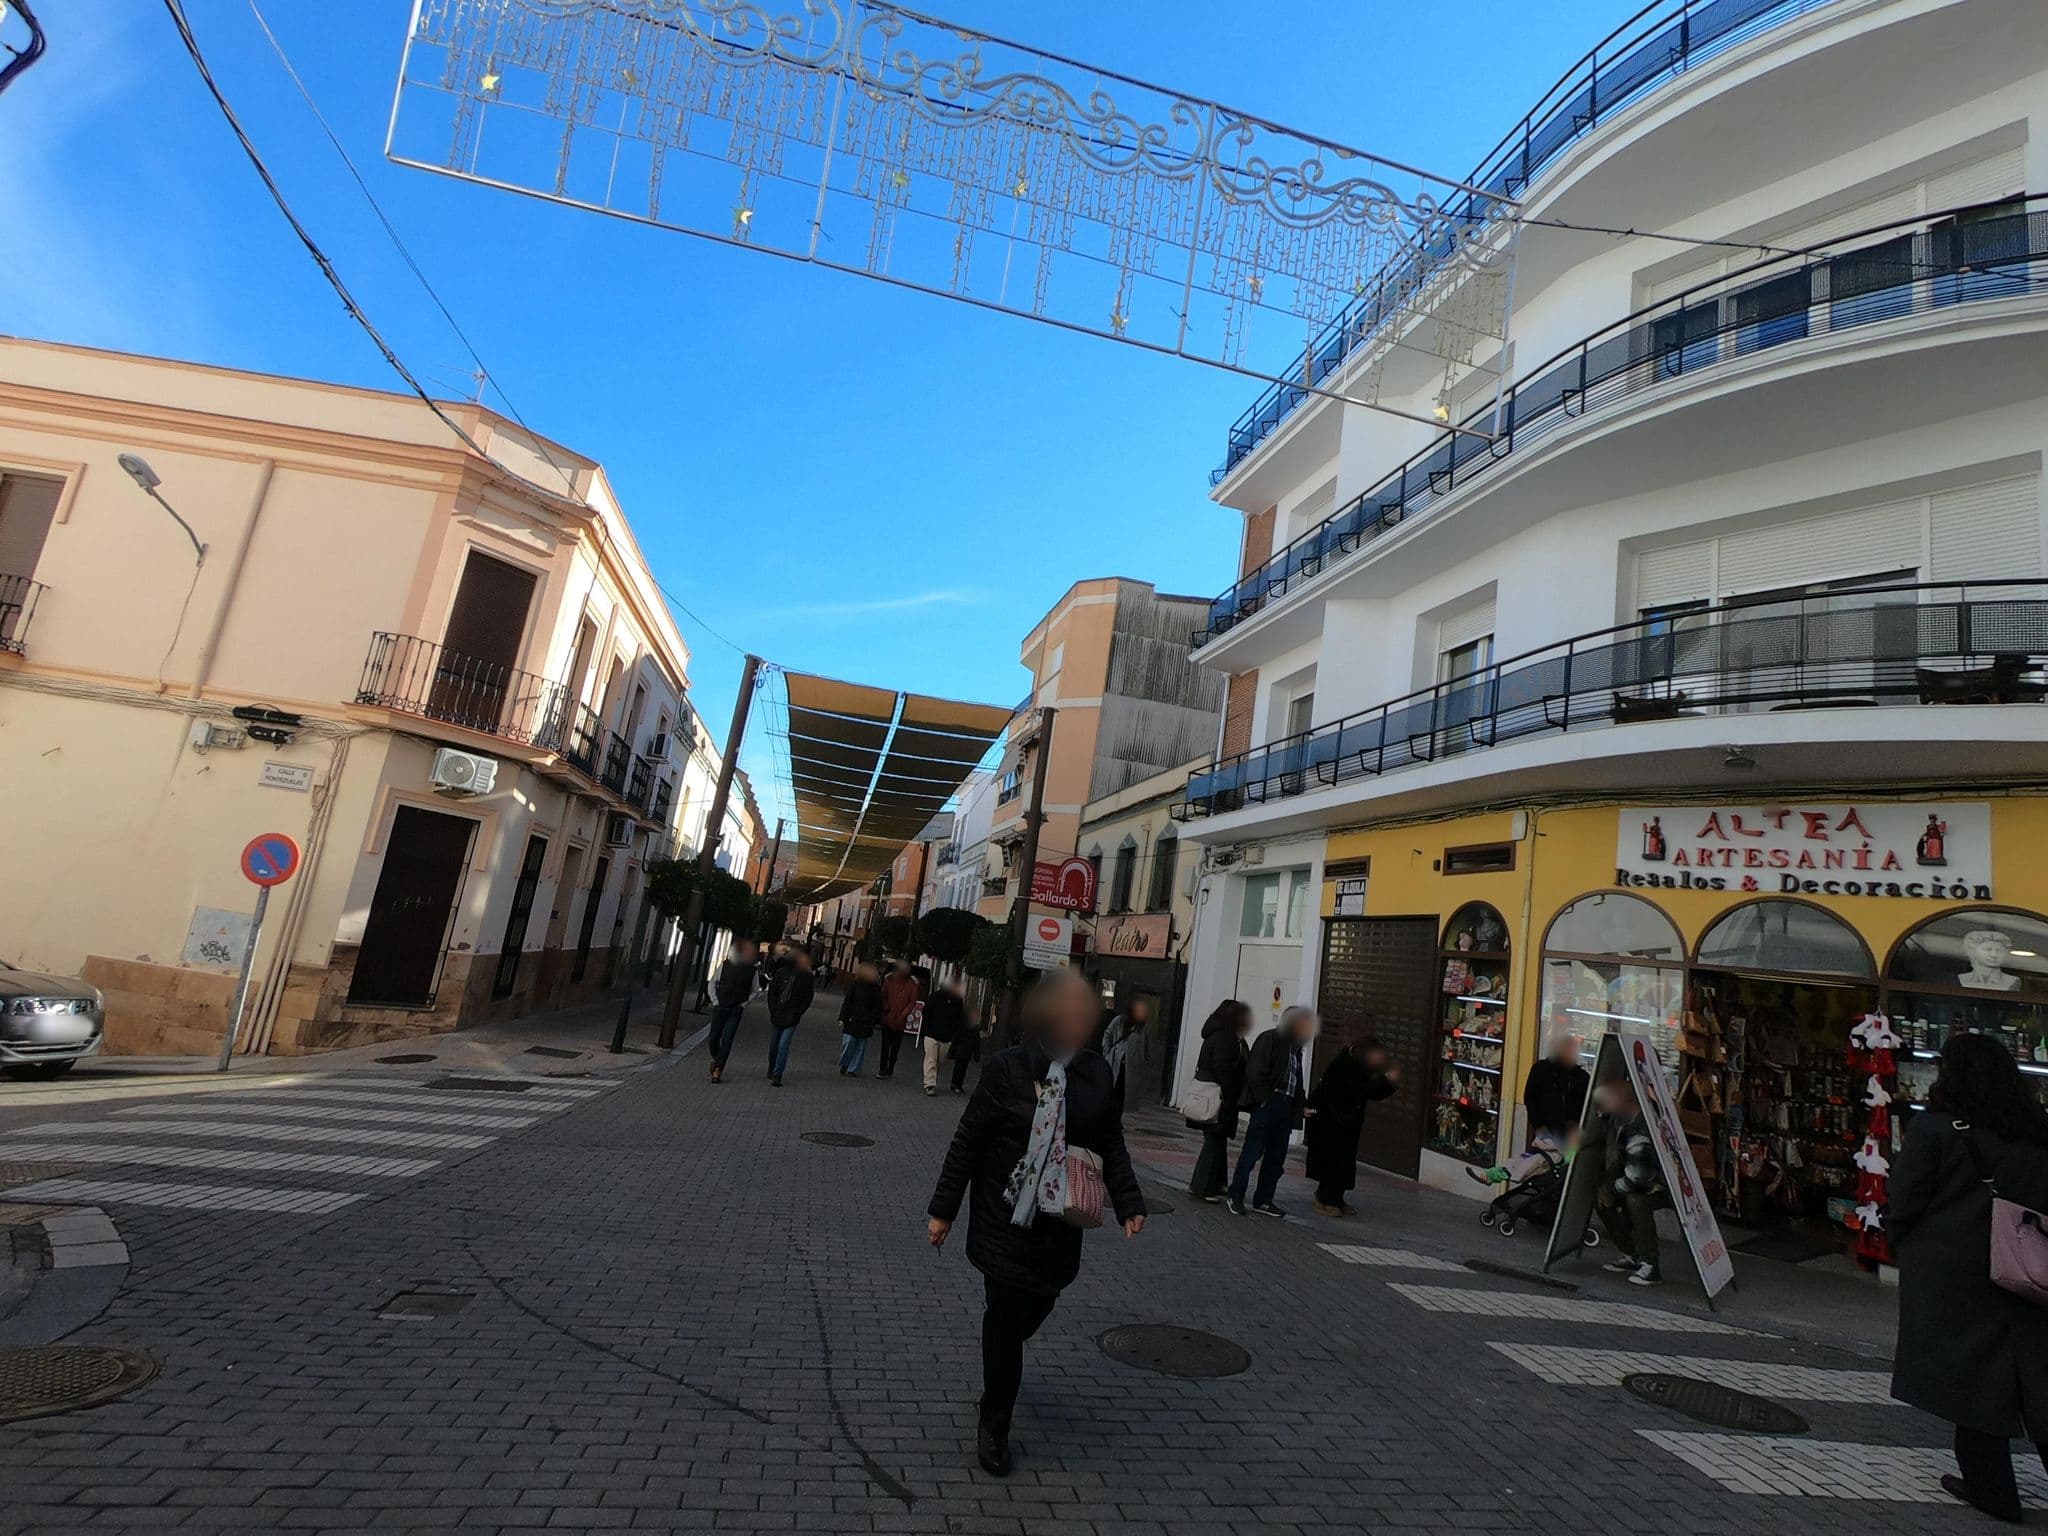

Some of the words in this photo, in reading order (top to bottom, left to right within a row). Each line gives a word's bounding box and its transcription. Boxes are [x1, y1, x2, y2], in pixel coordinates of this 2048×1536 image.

[278, 768, 296, 776] CALLE
[1696, 806, 1874, 841] ALTEA
[1672, 840, 1903, 871] ARTESANÍA
[1614, 868, 1728, 891] Regalos
[1739, 874, 1760, 893] &
[1778, 872, 1993, 900] Decoración
[1109, 916, 1149, 952] Teatro
